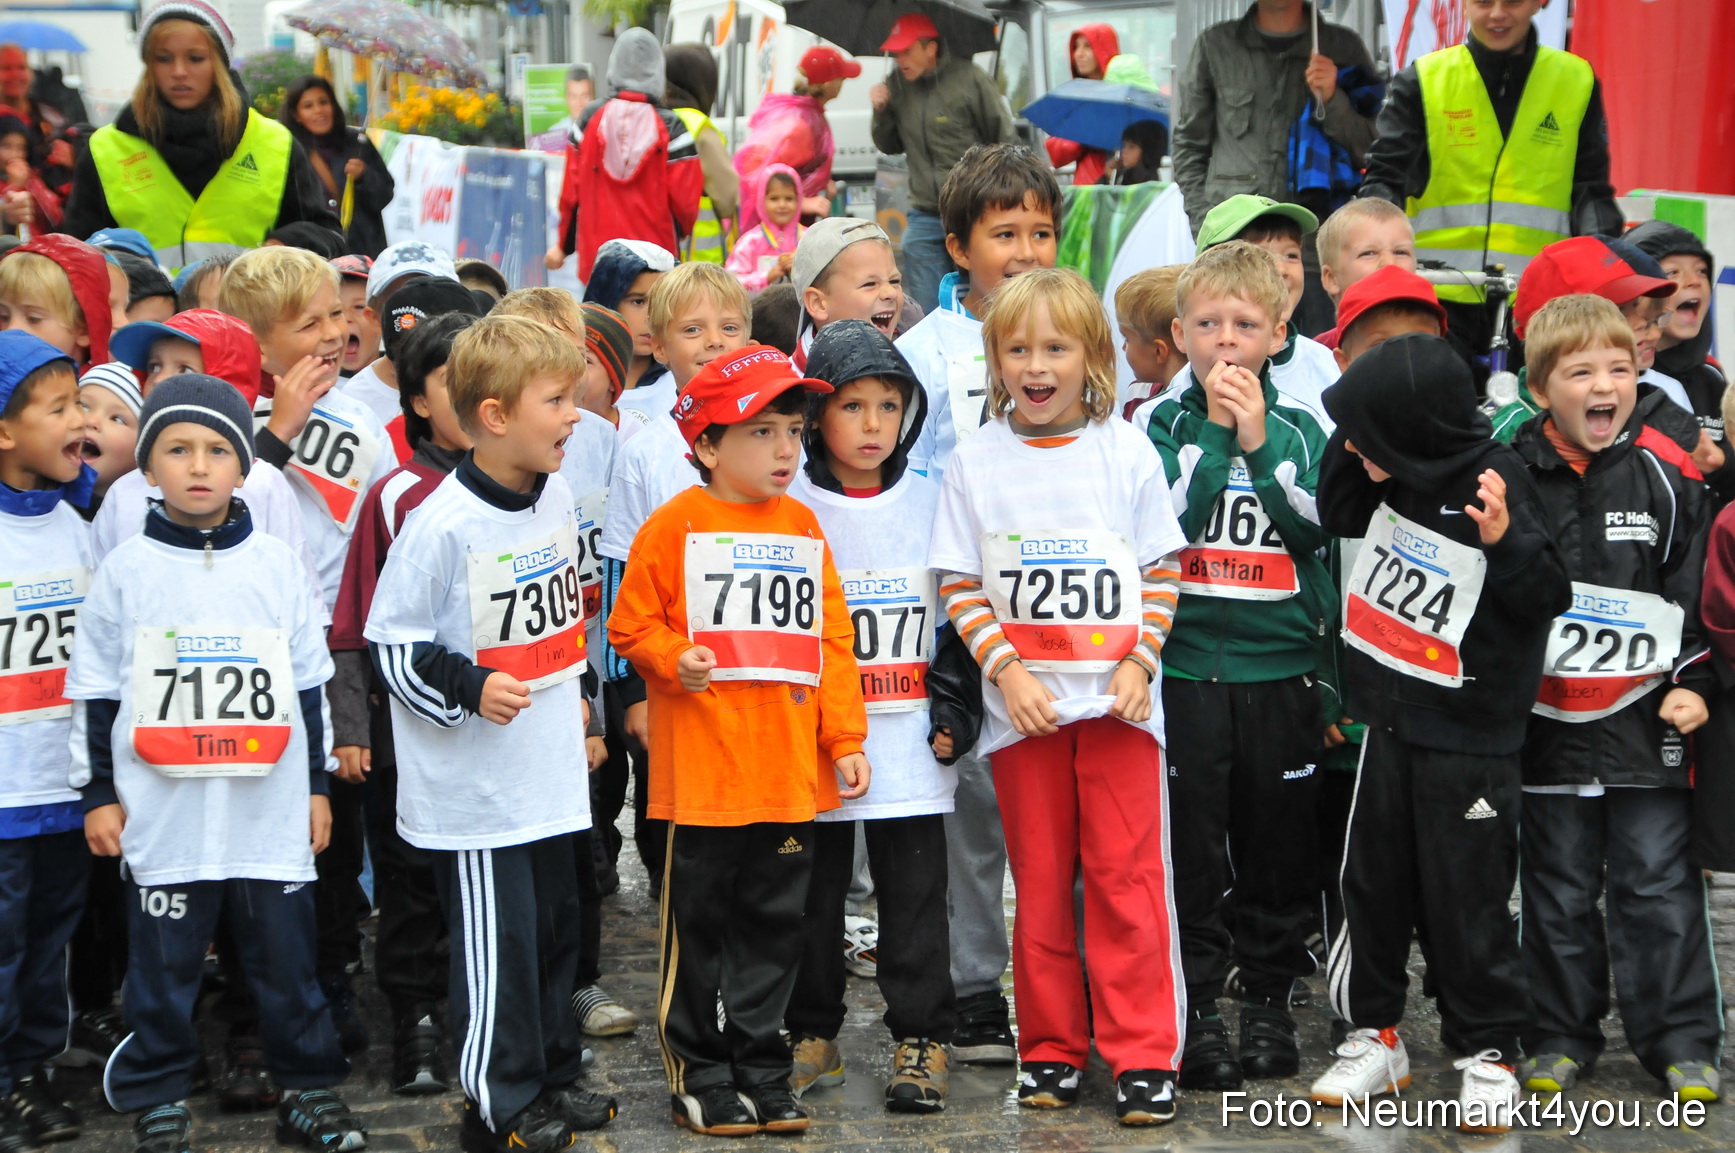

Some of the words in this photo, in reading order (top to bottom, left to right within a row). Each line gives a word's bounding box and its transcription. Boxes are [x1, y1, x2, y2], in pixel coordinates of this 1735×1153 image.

[721, 350, 786, 378] Ferrari
[1204, 492, 1283, 548] 062
[1605, 511, 1624, 525] FC
[733, 543, 795, 562] BOCK
[1021, 539, 1088, 555] BOCK
[1393, 526, 1439, 559] BOCK
[513, 543, 559, 574] BOCK
[1190, 556, 1264, 582] Bastian
[14, 579, 74, 601] BOCK
[842, 577, 909, 596] BOCK
[999, 568, 1121, 620] 7250
[1364, 544, 1456, 634] 7224
[490, 565, 580, 642] 7309
[704, 573, 815, 630] 7198
[0, 609, 76, 670] 725
[176, 636, 242, 653] BOCK
[850, 606, 927, 661] 077
[1551, 622, 1658, 672] 220
[527, 640, 565, 669] Tim
[153, 666, 275, 721] 7128
[860, 671, 910, 696] Thilo
[138, 714, 143, 724] 2
[281, 713, 290, 723] M
[192, 734, 237, 757] Tim
[1283, 768, 1310, 780] JAKO
[1464, 809, 1498, 820] adidas
[777, 844, 803, 854] adidas
[138, 887, 188, 920] 105
